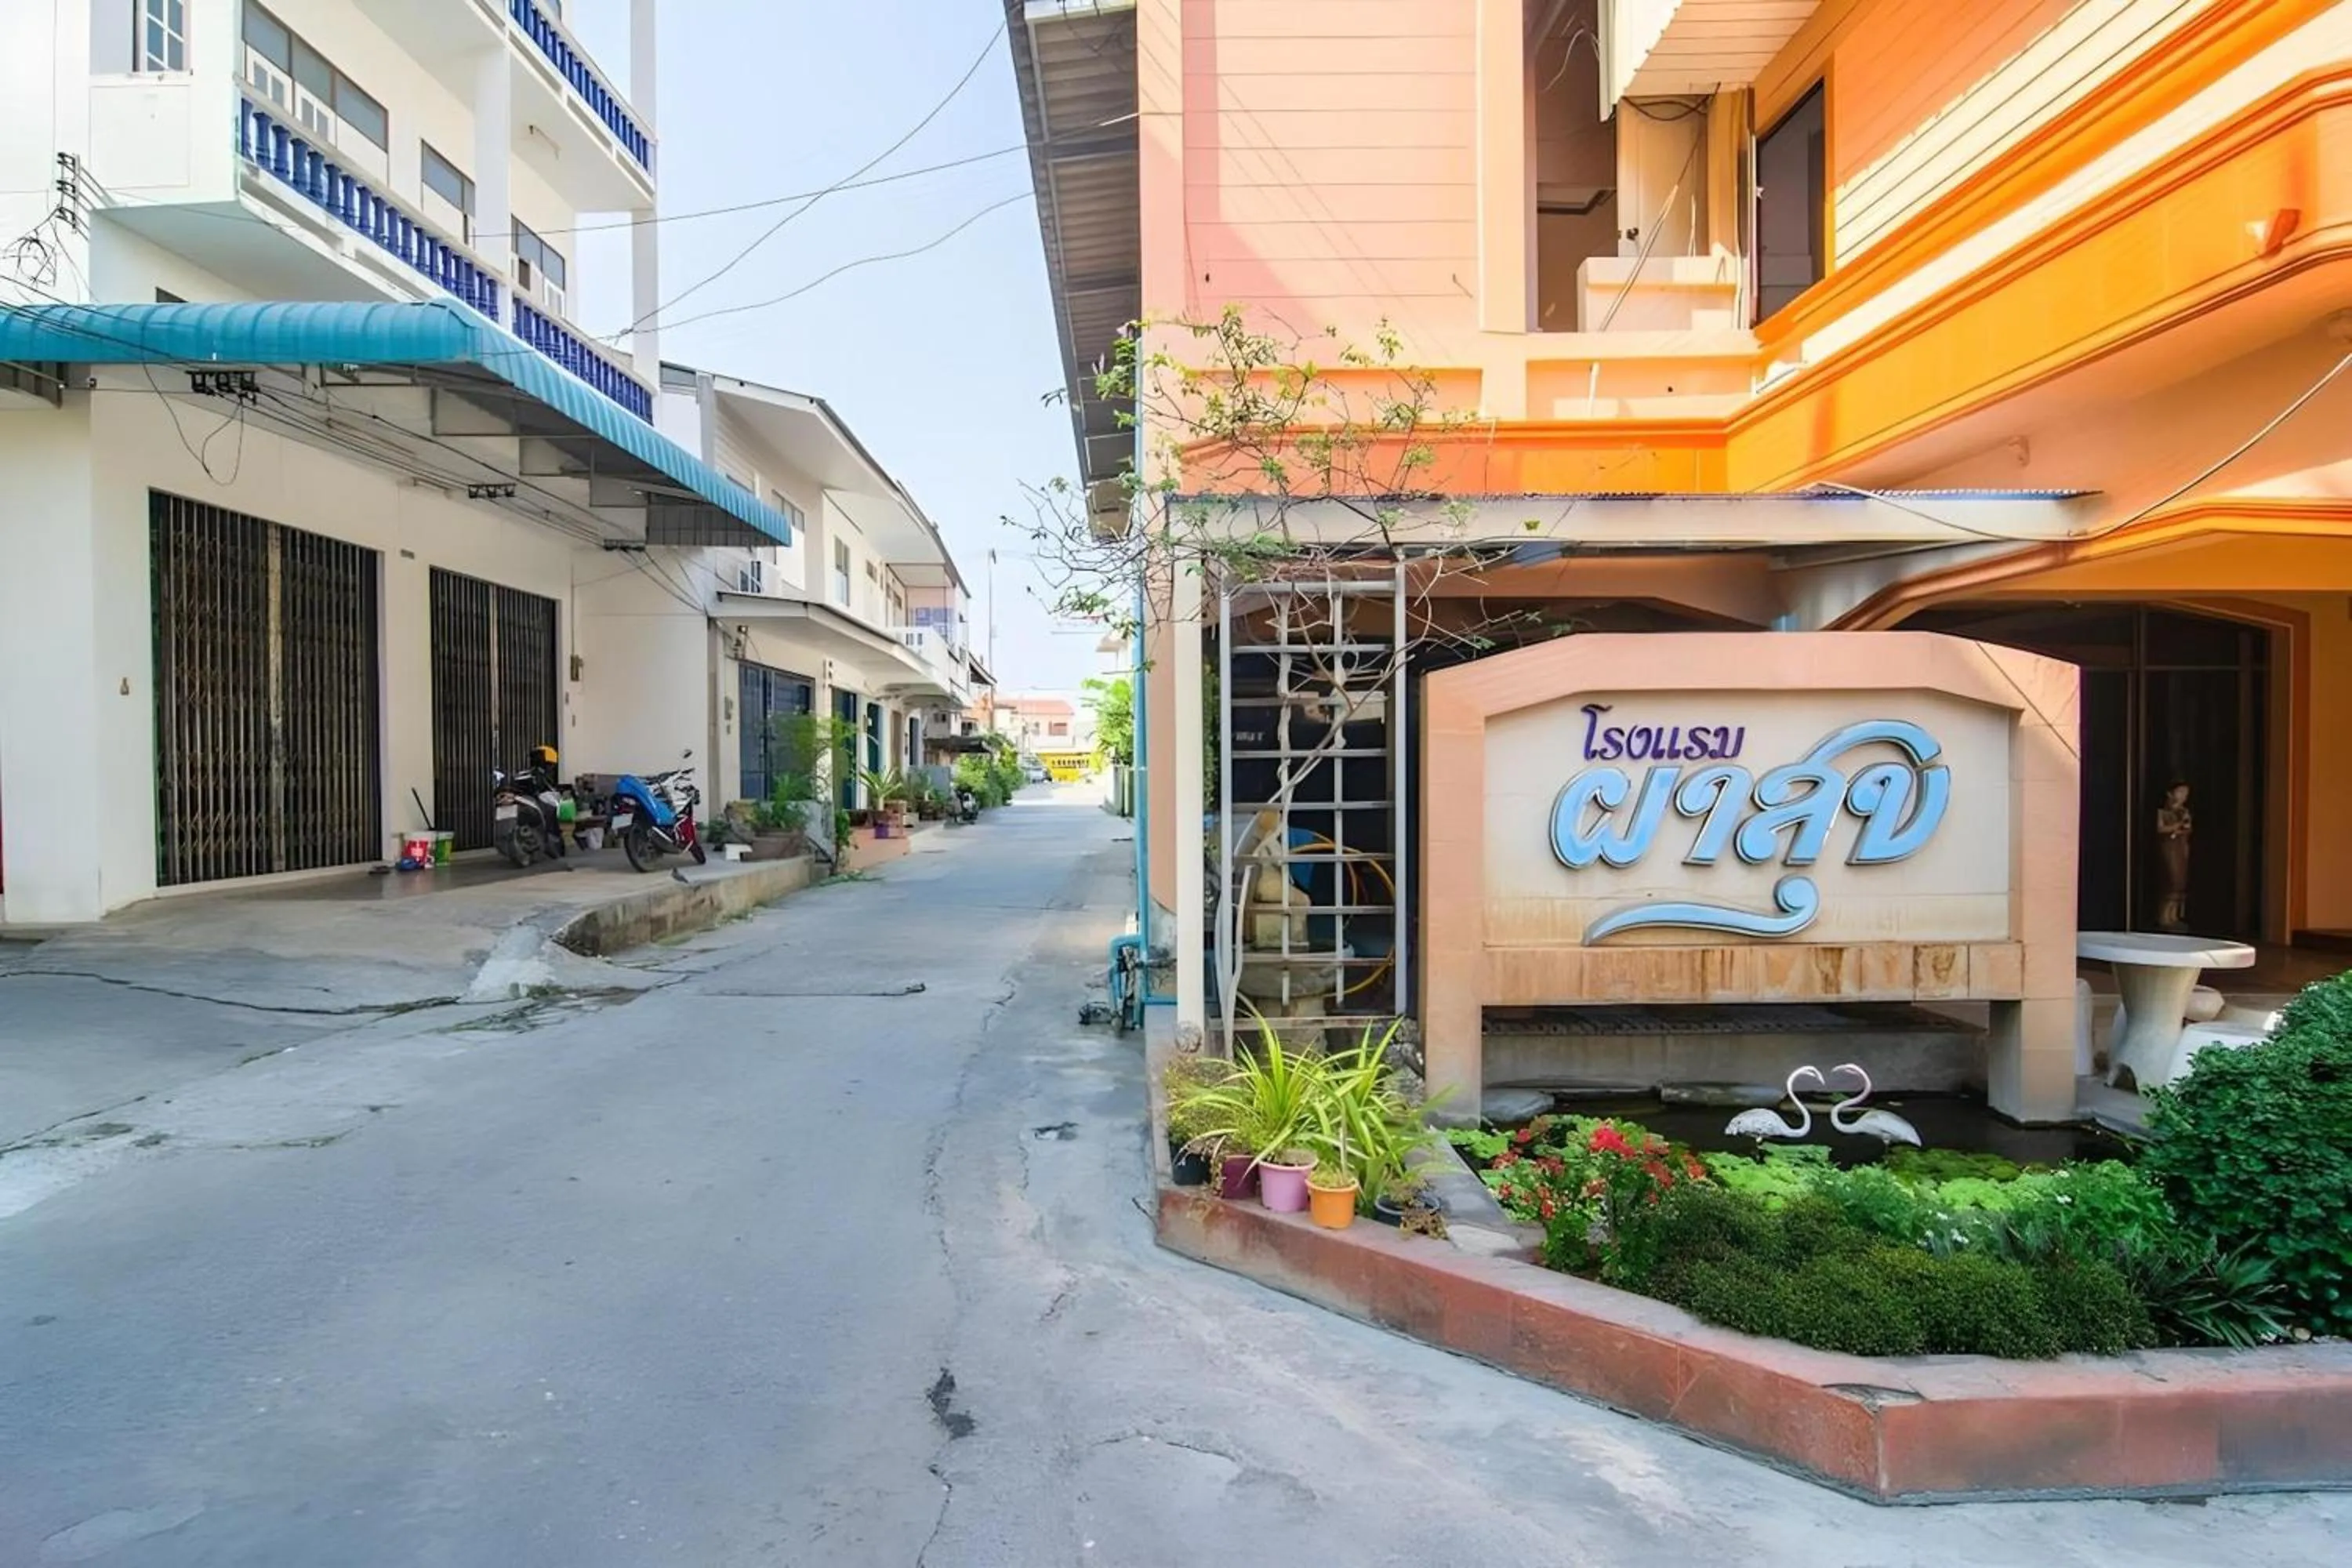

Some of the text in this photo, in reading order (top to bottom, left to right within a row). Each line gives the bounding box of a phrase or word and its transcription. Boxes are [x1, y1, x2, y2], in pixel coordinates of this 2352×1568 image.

[1581, 704, 1745, 760] โรงแรม
[1548, 719, 1951, 946] ผาสุข
